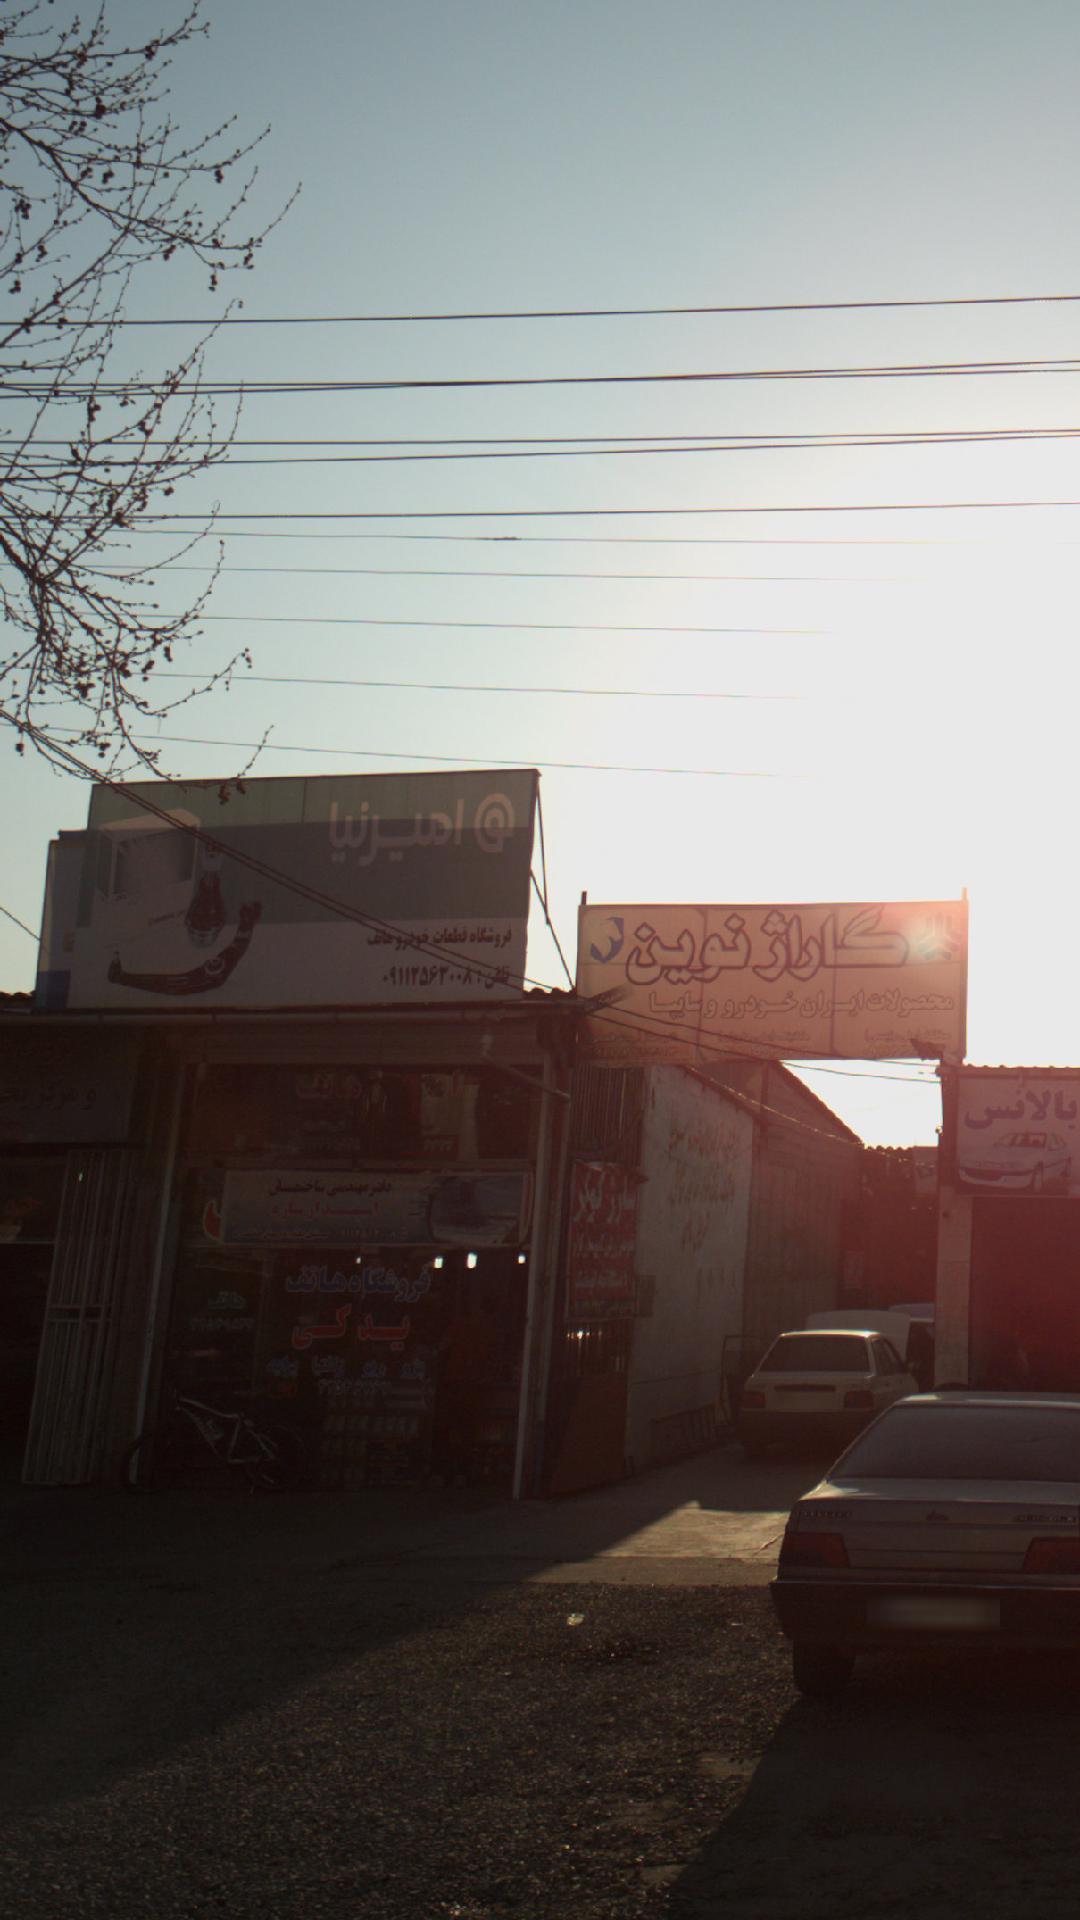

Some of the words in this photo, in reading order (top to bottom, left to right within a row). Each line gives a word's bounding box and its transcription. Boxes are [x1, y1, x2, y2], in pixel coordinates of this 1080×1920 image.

[469, 928, 512, 948] فروشگاه
[625, 912, 752, 985] نوین
[752, 905, 910, 983] گاراژ
[723, 991, 799, 1019] خودرو
[800, 988, 864, 1018] ایران
[865, 988, 954, 1018] محصولات
[964, 1088, 1078, 1130] بالانس
[348, 1263, 432, 1302] فروشگاه
